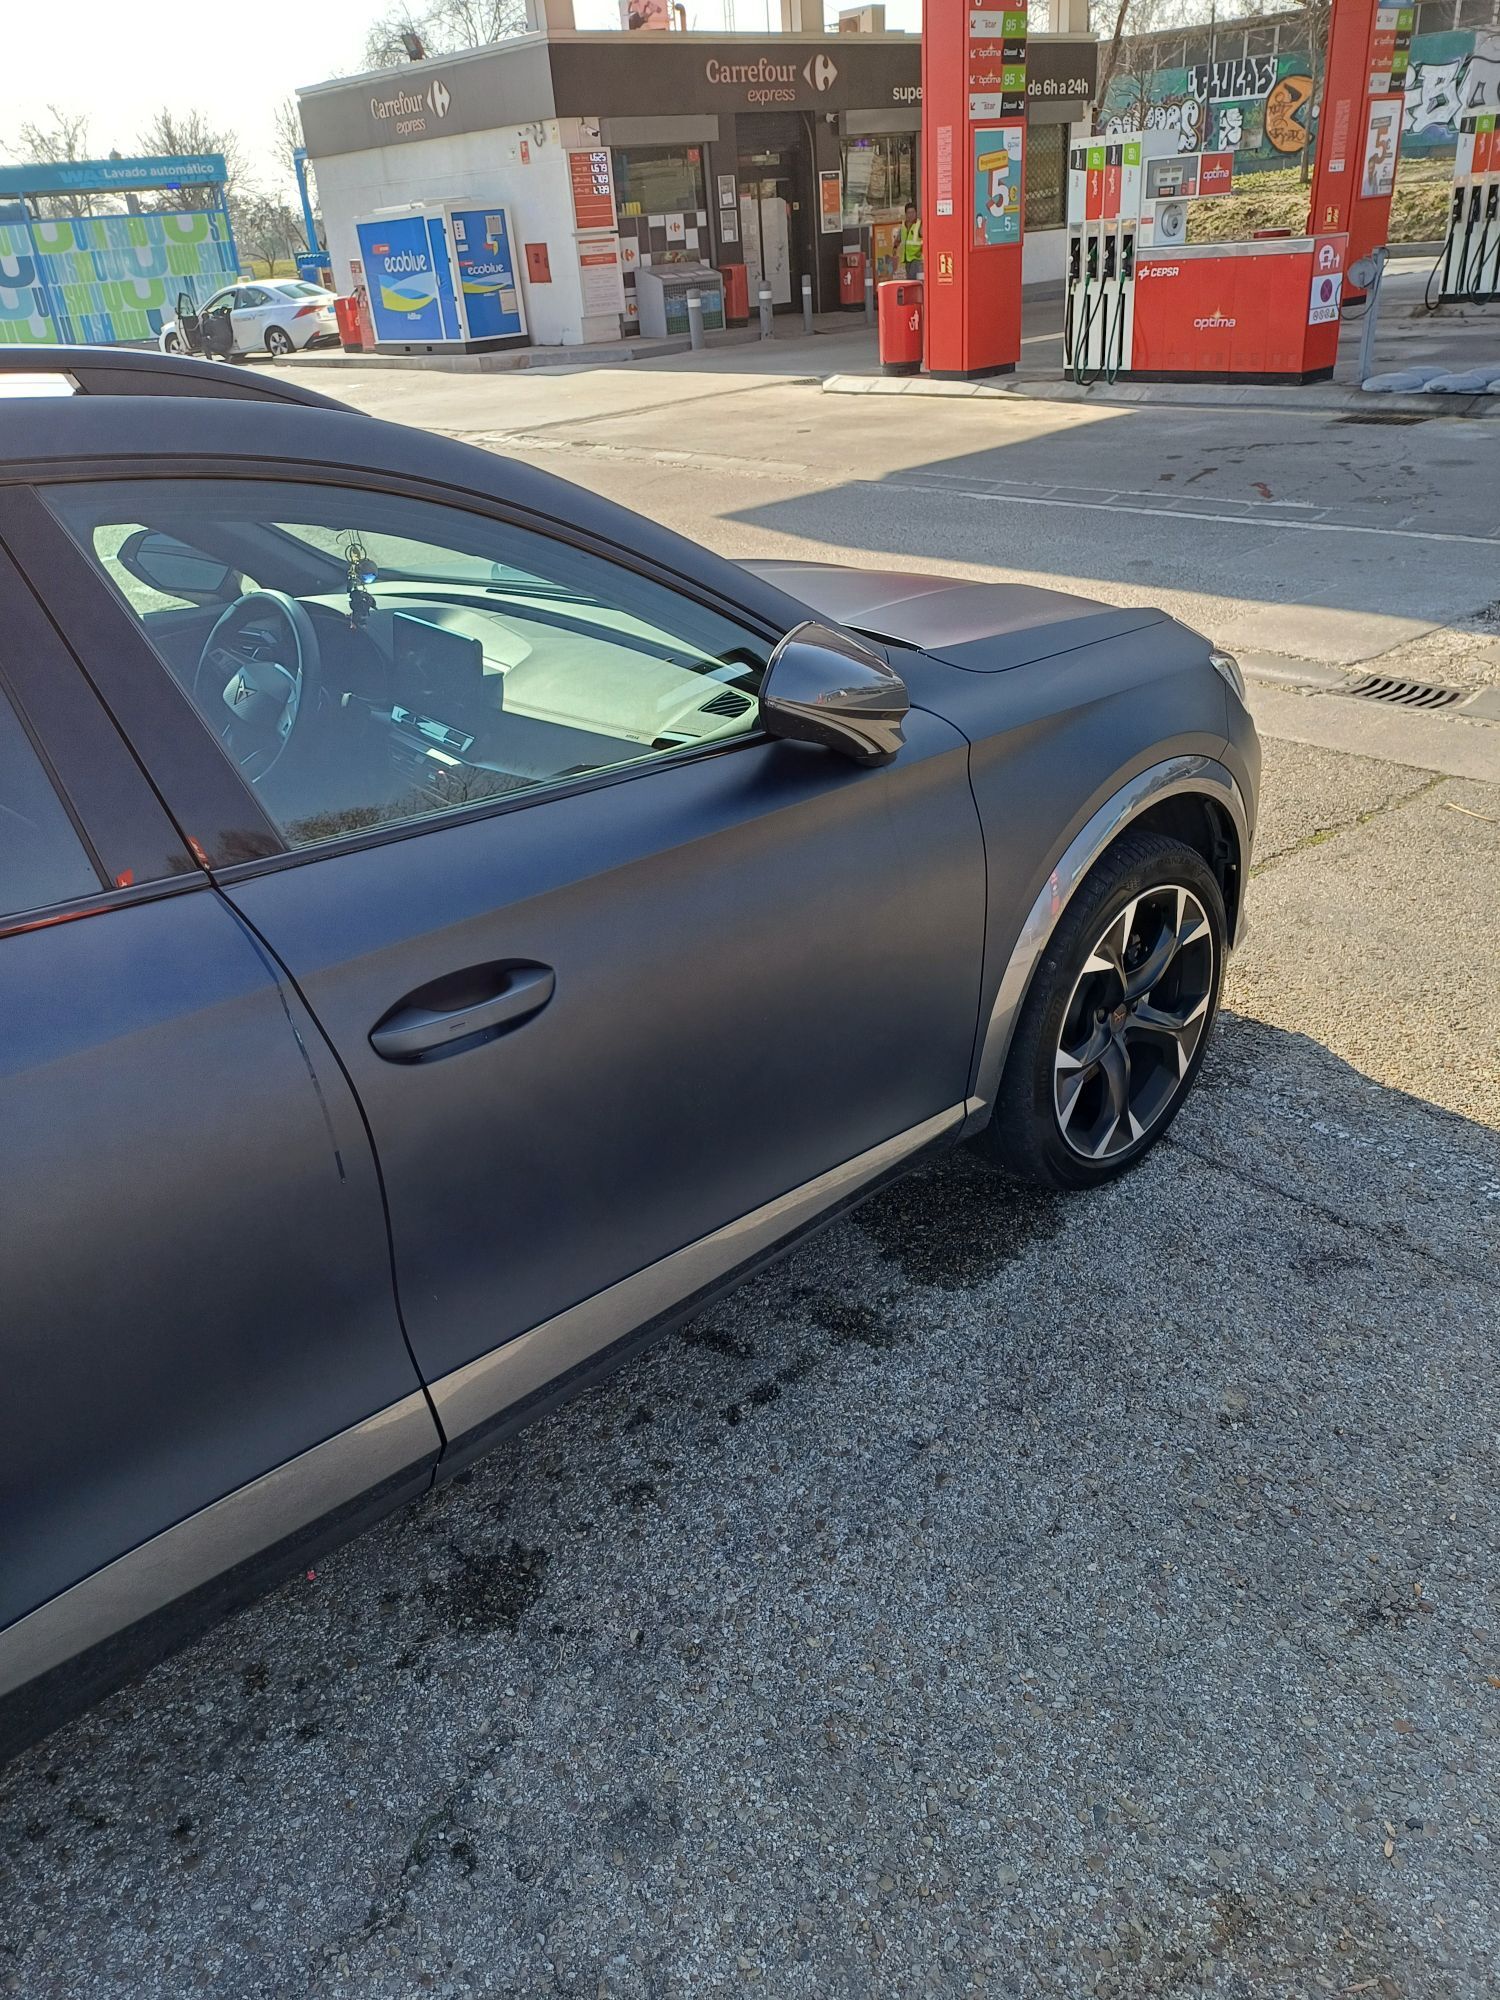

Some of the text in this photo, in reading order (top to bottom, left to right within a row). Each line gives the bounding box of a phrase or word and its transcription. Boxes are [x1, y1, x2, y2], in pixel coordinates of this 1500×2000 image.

[1005, 19, 1017, 31] 95
[706, 57, 797, 84] Carrefour
[1004, 73, 1015, 85] 95
[1027, 79, 1042, 96] de
[1043, 78, 1058, 95] 6h
[1059, 82, 1066, 95] a
[1067, 78, 1089, 95] 24h
[370, 90, 423, 120] Carrefour
[747, 88, 796, 106] express
[396, 118, 426, 136] express
[103, 163, 214, 179] Lavado automático
[1203, 169, 1230, 182] optima
[987, 166, 1009, 217] 5
[1003, 216, 1011, 232] 5
[384, 250, 428, 273] ecoblue
[467, 262, 504, 276] ecoblue
[1150, 267, 1180, 277] CEPSA
[1194, 316, 1236, 331] optima
